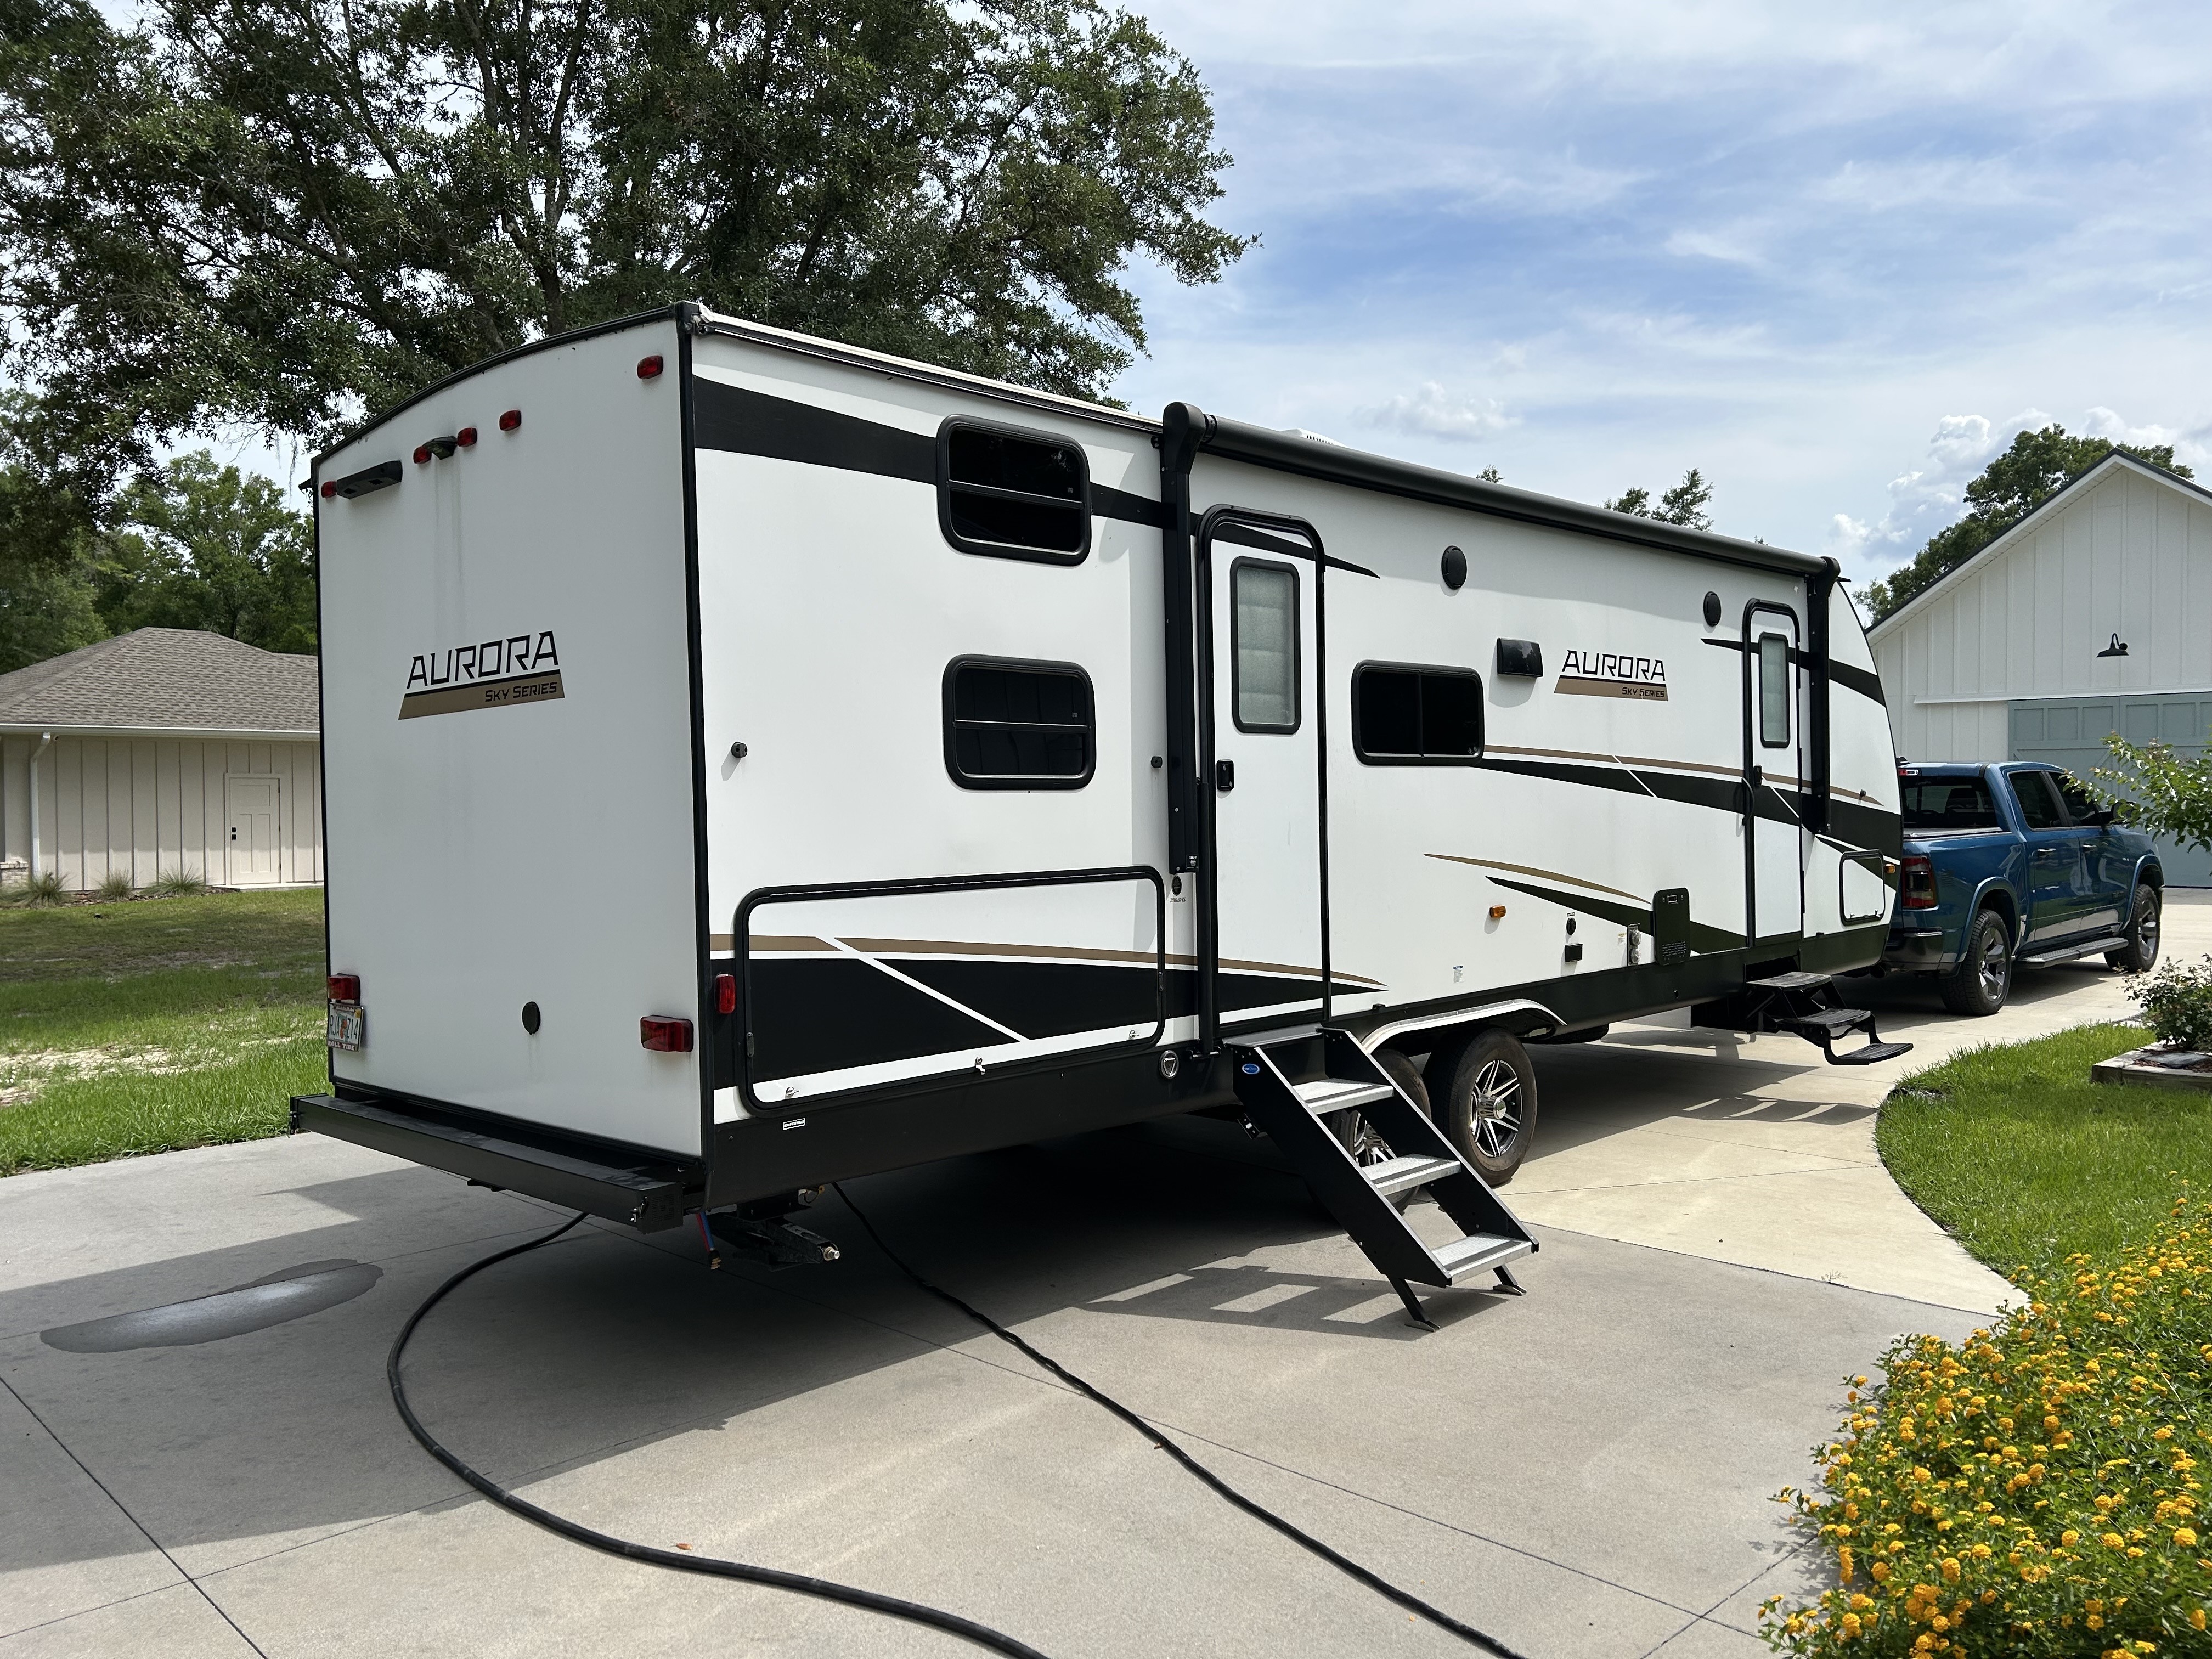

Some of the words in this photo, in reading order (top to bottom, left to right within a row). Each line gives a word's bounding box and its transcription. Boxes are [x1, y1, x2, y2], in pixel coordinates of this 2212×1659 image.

[407, 630, 558, 689] AURORA
[1561, 650, 1666, 681] AURORA
[485, 689, 510, 702] SKY
[513, 681, 557, 698] SERIES
[1622, 686, 1638, 696] SKY
[1639, 688, 1664, 697] SERIES
